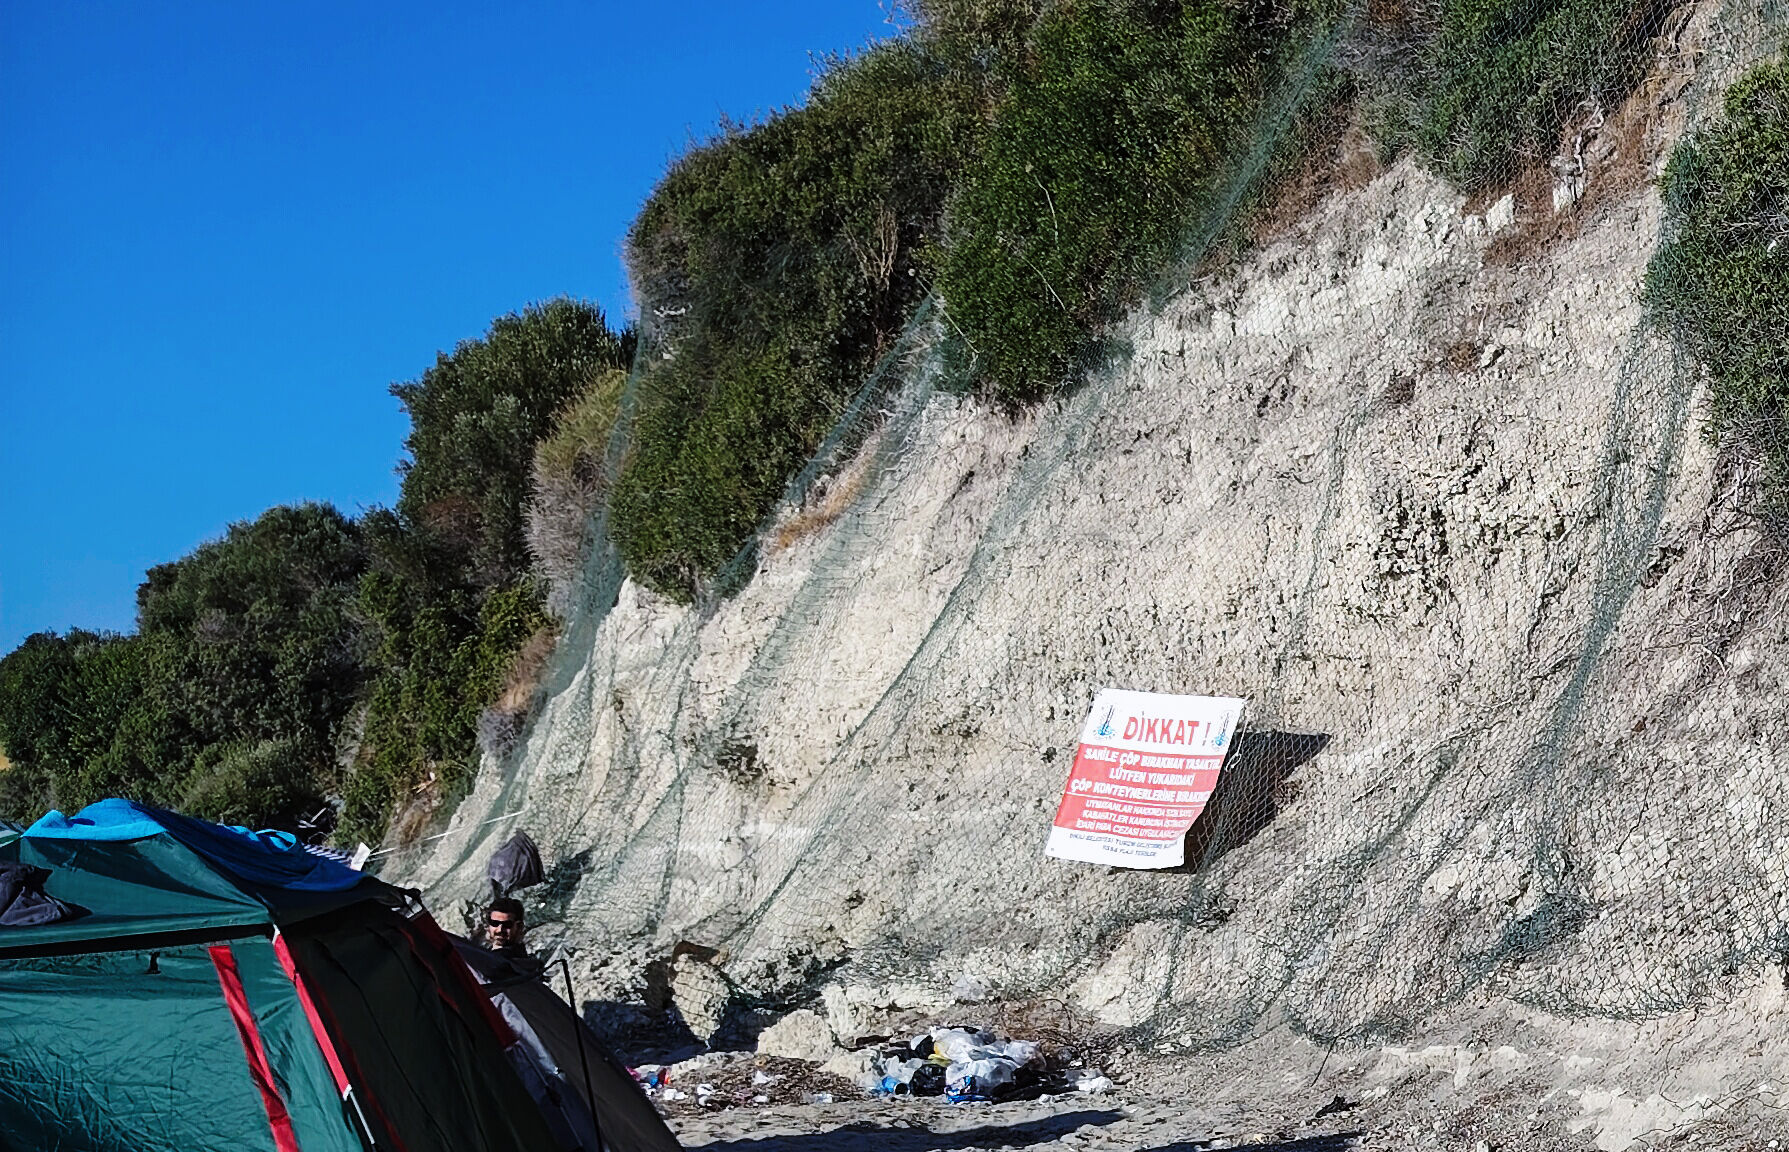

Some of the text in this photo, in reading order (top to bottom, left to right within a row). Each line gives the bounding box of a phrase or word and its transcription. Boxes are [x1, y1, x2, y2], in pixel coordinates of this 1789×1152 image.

[1122, 711, 1200, 746] DİKKAT
[1120, 751, 1141, 769] ÇÖP
[1109, 766, 1147, 784] LÜTFEN
[1071, 777, 1093, 793] ÇÖP
